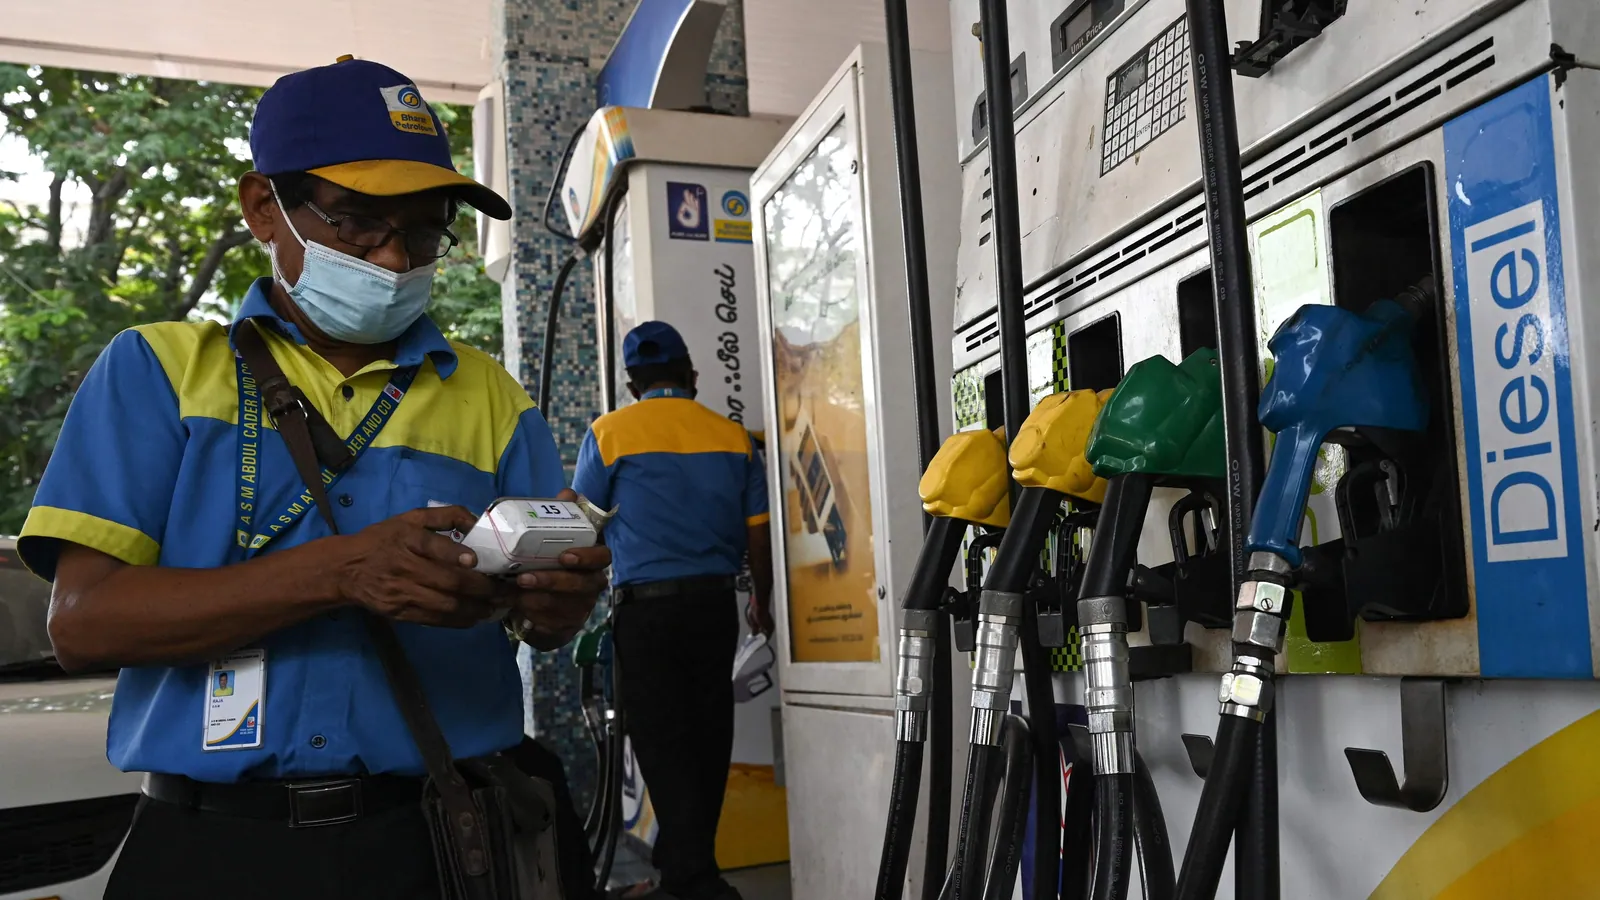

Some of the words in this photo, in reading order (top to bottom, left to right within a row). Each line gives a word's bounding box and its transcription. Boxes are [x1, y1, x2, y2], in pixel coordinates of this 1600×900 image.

[1070, 38, 1084, 54] Unit
[1085, 21, 1103, 41] Price
[1197, 53, 1207, 89] OPW
[401, 114, 427, 123] Bharat
[1202, 93, 1210, 120] VAPOR
[395, 121, 433, 132] Petroleum
[1136, 122, 1151, 138] ENTER
[1205, 122, 1214, 163] RECOVERY
[713, 263, 738, 323] செய்
[243, 377, 257, 397] AND
[1471, 219, 1558, 545] Diesel
[243, 399, 257, 438] CADER
[241, 443, 256, 483] ABDUL
[279, 515, 291, 523] S
[287, 502, 304, 515] M
[362, 413, 382, 438] AND
[377, 399, 392, 416] CO
[241, 486, 254, 499] M
[1231, 459, 1241, 497] OPW
[241, 502, 252, 511] S
[241, 516, 250, 525] A
[541, 505, 561, 514] 15
[1234, 502, 1242, 529] VAPOR
[1235, 533, 1243, 576] RECOVERY
